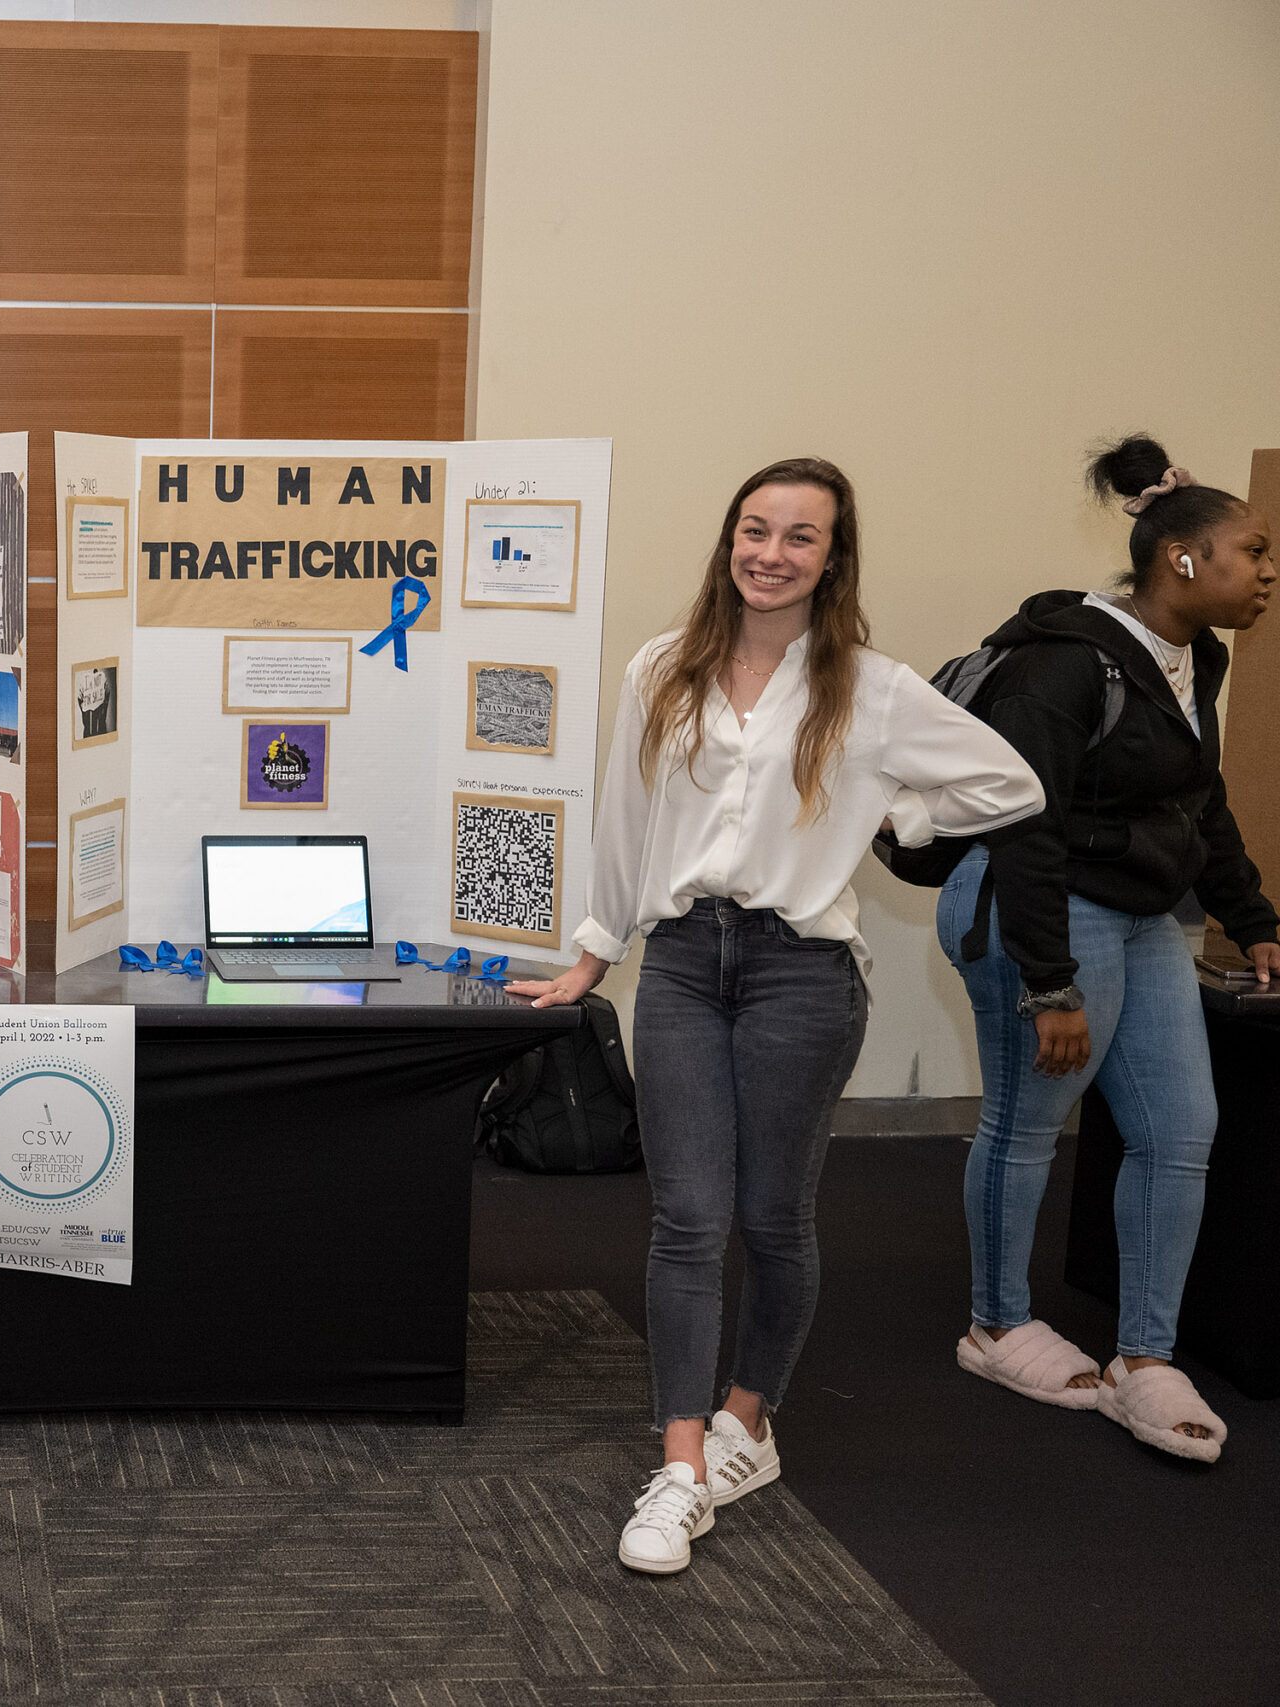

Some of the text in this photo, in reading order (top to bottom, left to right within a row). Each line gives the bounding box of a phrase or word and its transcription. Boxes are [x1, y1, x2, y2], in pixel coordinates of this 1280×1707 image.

[159, 464, 431, 505] HUMAN
[475, 481, 536, 500] Under 21:
[142, 540, 438, 580] TRAFFICKING
[265, 763, 299, 774] planet
[269, 772, 306, 780] fitness
[458, 778, 480, 790] Survey
[483, 782, 498, 790] about
[501, 784, 527, 792] personal
[30, 1019, 60, 1028] Union
[64, 1020, 107, 1029] Ballroom
[20, 1033, 26, 1043] 1,
[30, 1033, 55, 1042] 2022
[85, 1035, 105, 1044] p.m.
[22, 1130, 72, 1146] CSW
[12, 1154, 83, 1163] CELEBRATION
[21, 1162, 82, 1174] of STUDENT
[19, 1173, 81, 1183] WRITING
[101, 1235, 125, 1243] BLUE
